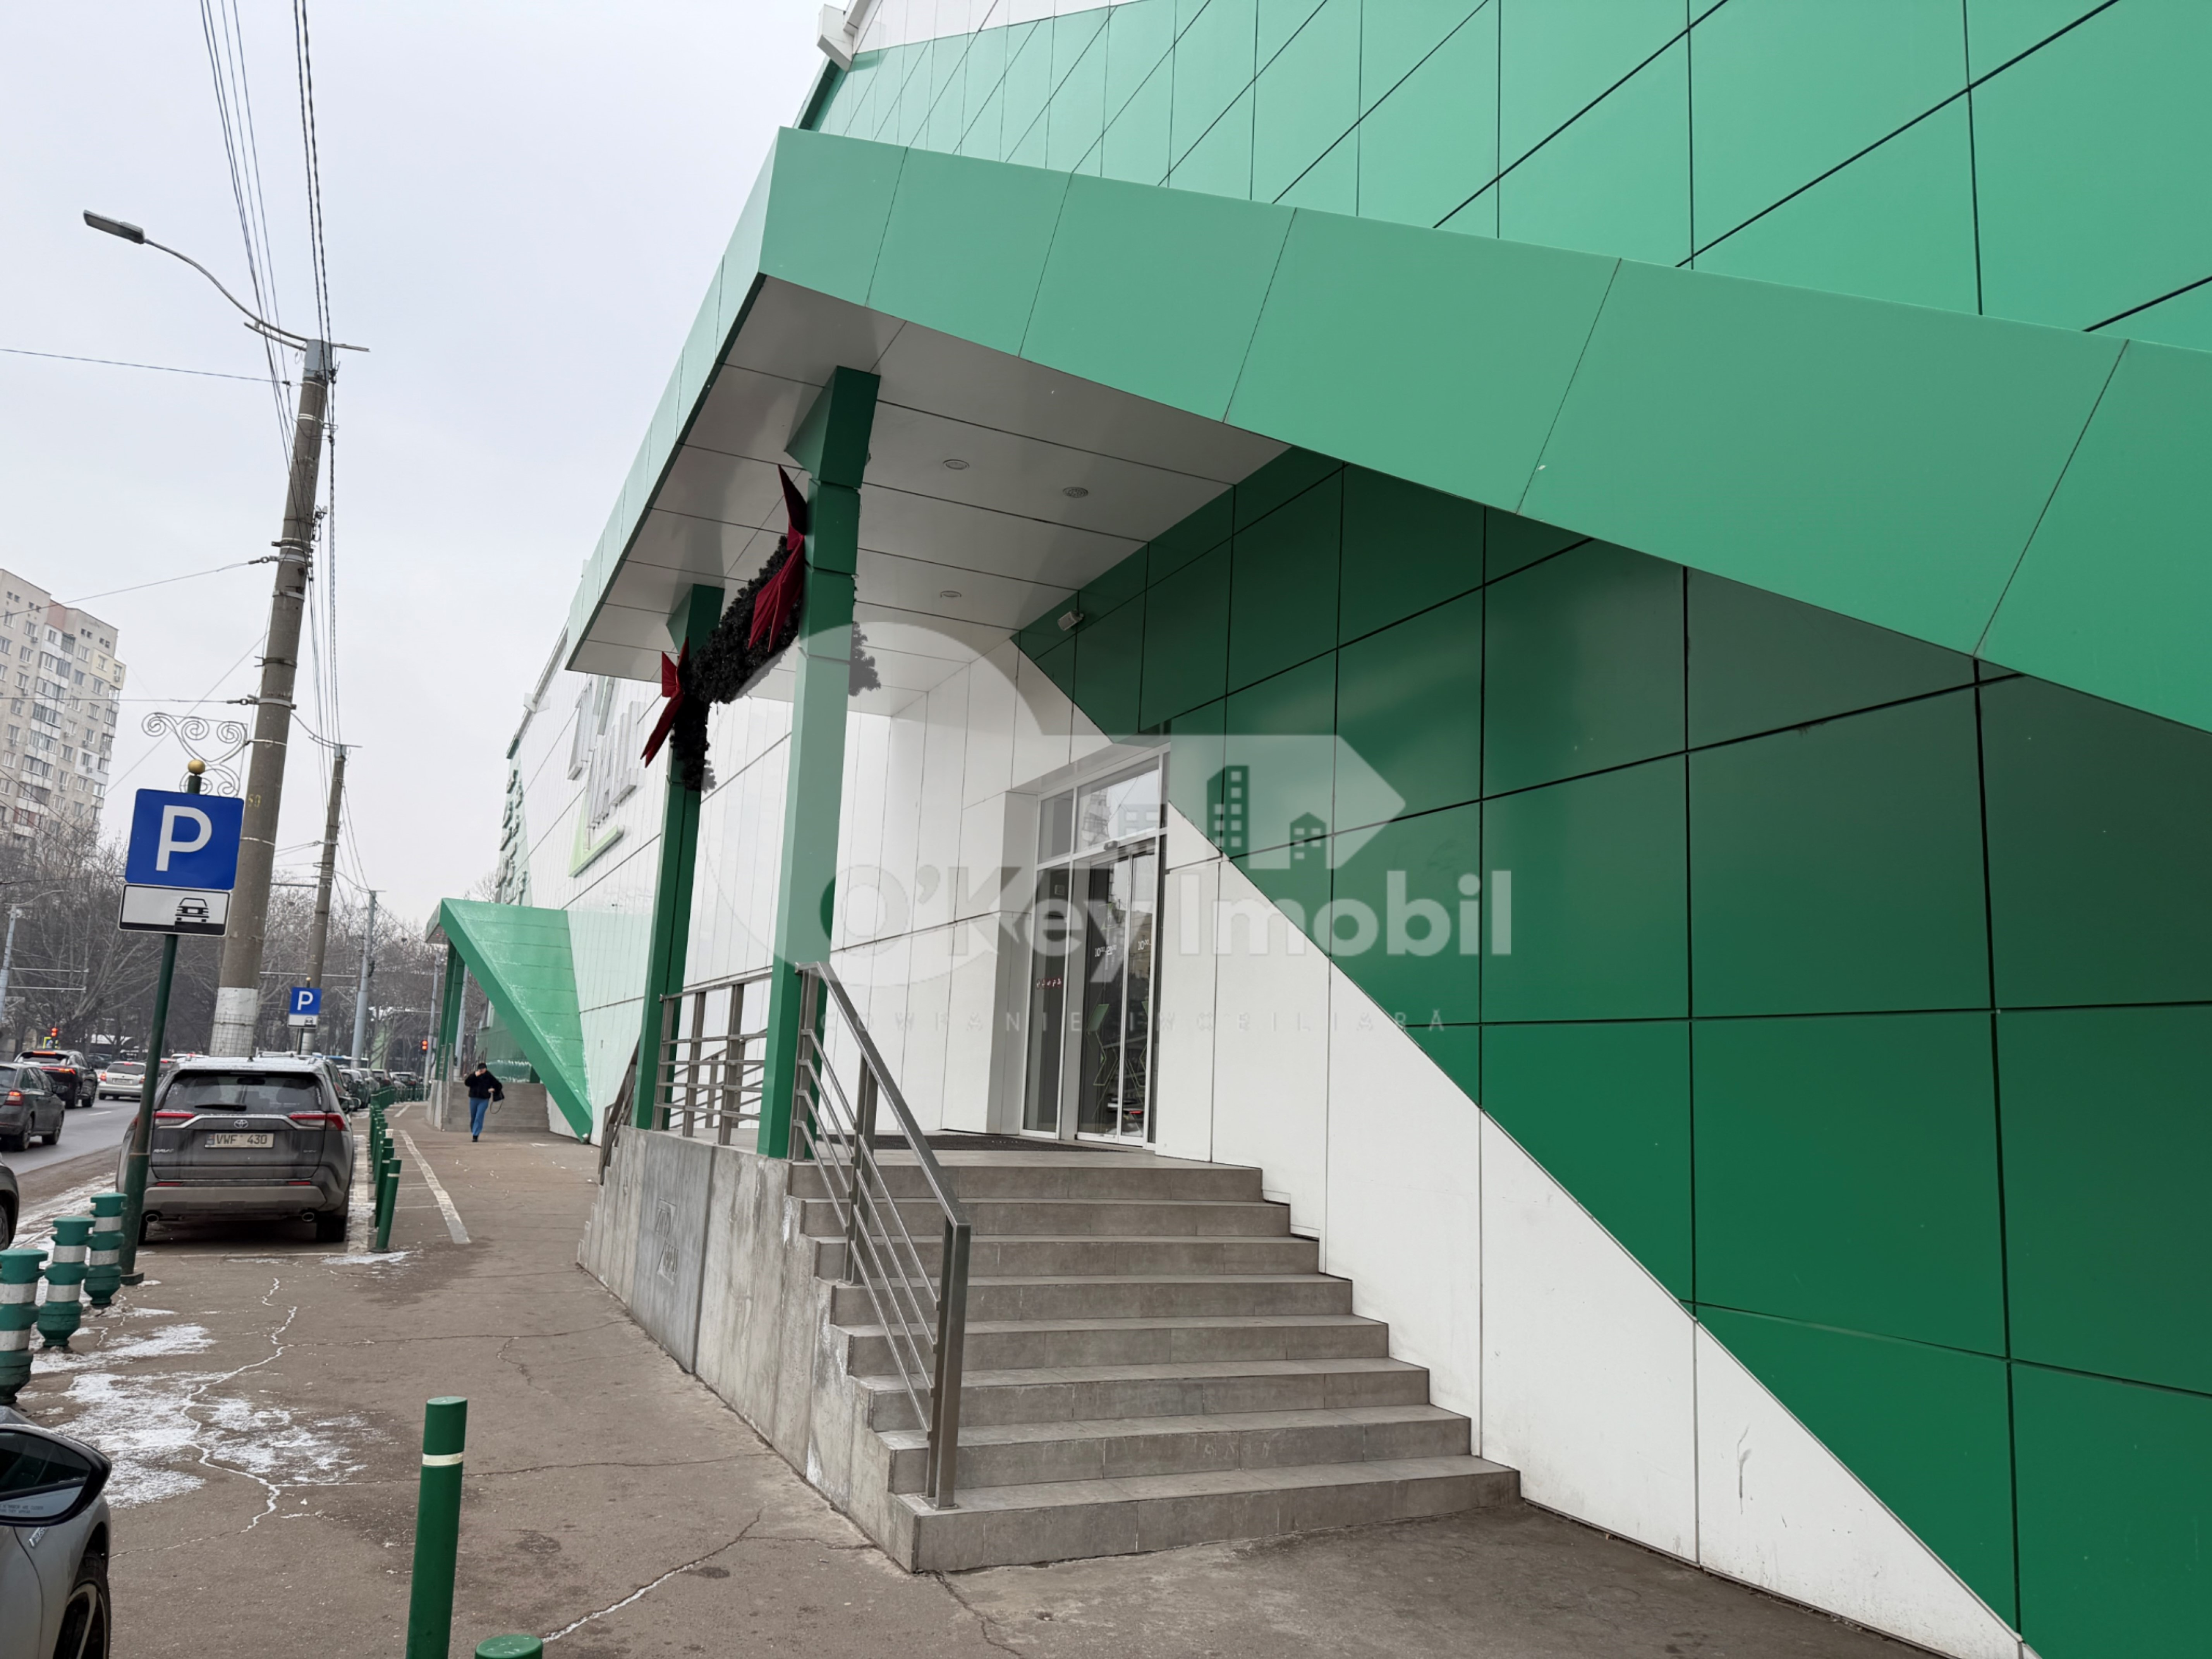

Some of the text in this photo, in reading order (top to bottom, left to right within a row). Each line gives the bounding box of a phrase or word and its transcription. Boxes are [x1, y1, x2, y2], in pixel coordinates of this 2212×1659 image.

[156, 805, 212, 871] P
[297, 991, 313, 1010] P
[216, 1134, 238, 1144] VWF
[247, 1134, 267, 1144] 430
